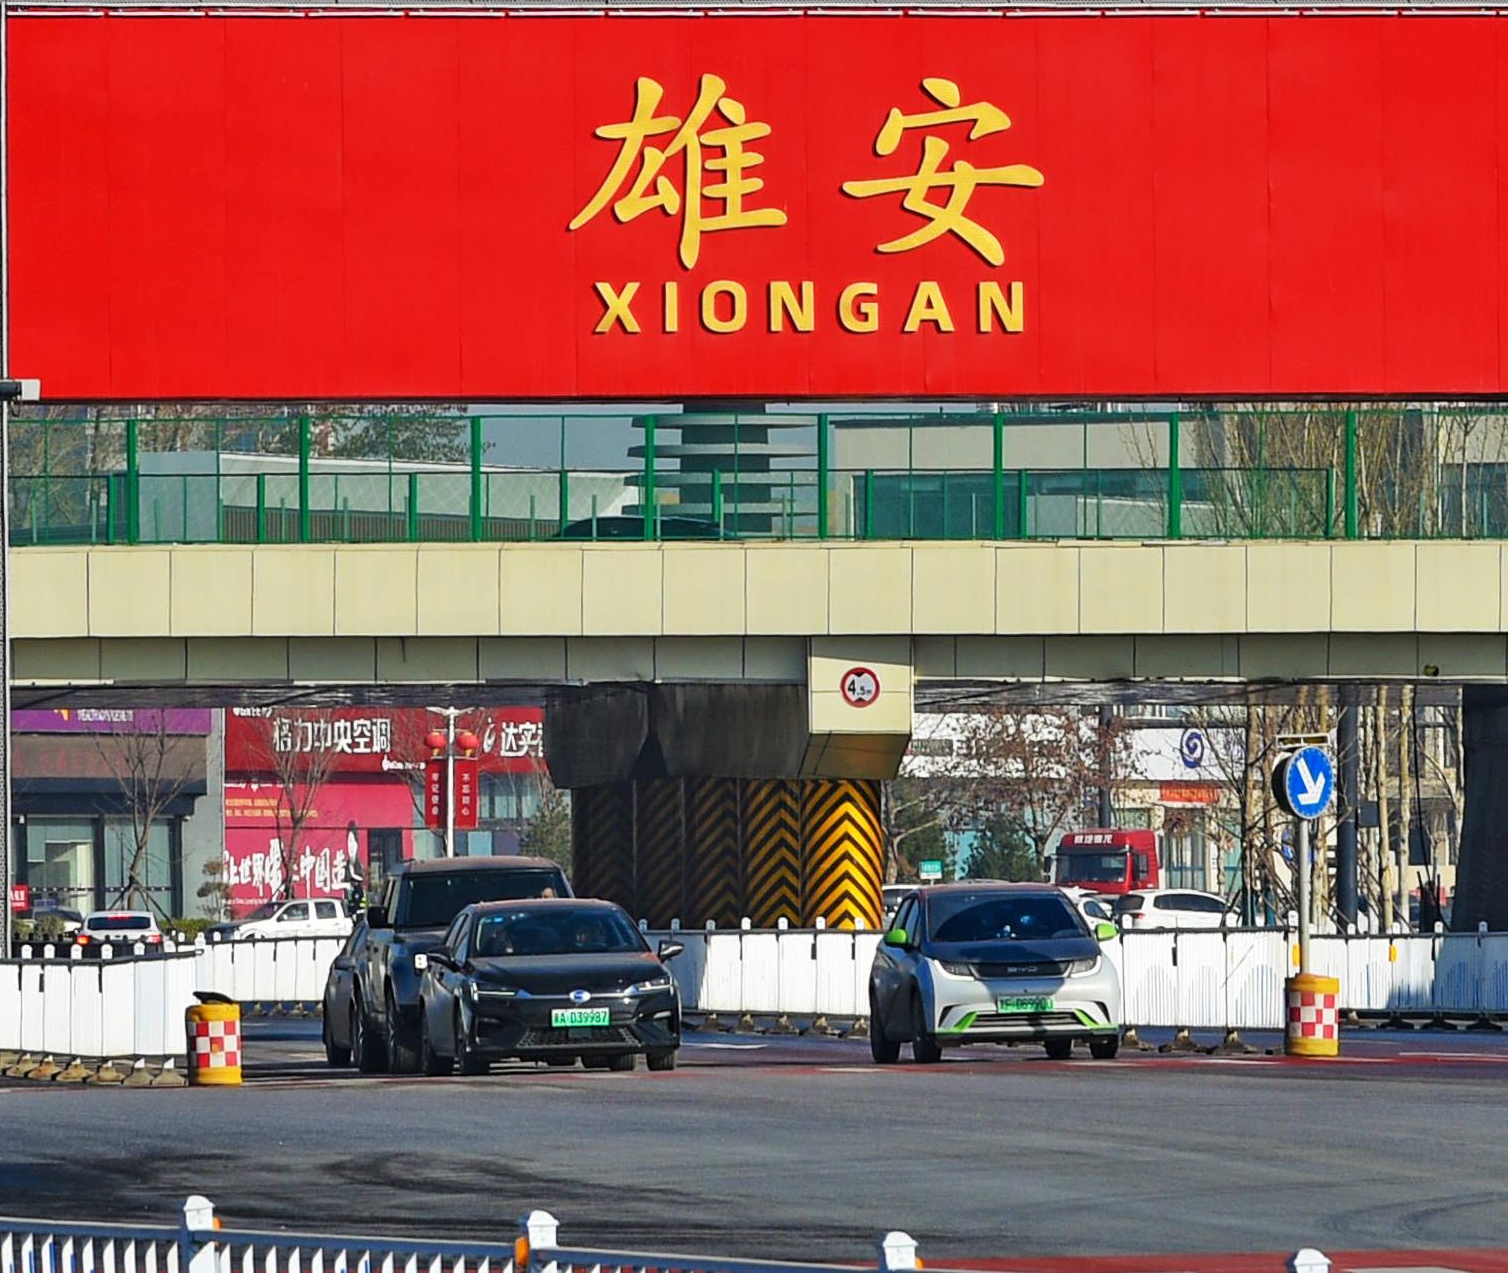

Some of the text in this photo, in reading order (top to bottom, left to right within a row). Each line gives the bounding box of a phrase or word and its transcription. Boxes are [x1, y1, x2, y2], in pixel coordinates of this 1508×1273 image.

[569, 73, 1045, 269] 雄安
[594, 280, 1025, 333] XIONGAN
[273, 717, 391, 753] 格力中央空调
[500, 722, 543, 757] 达实
